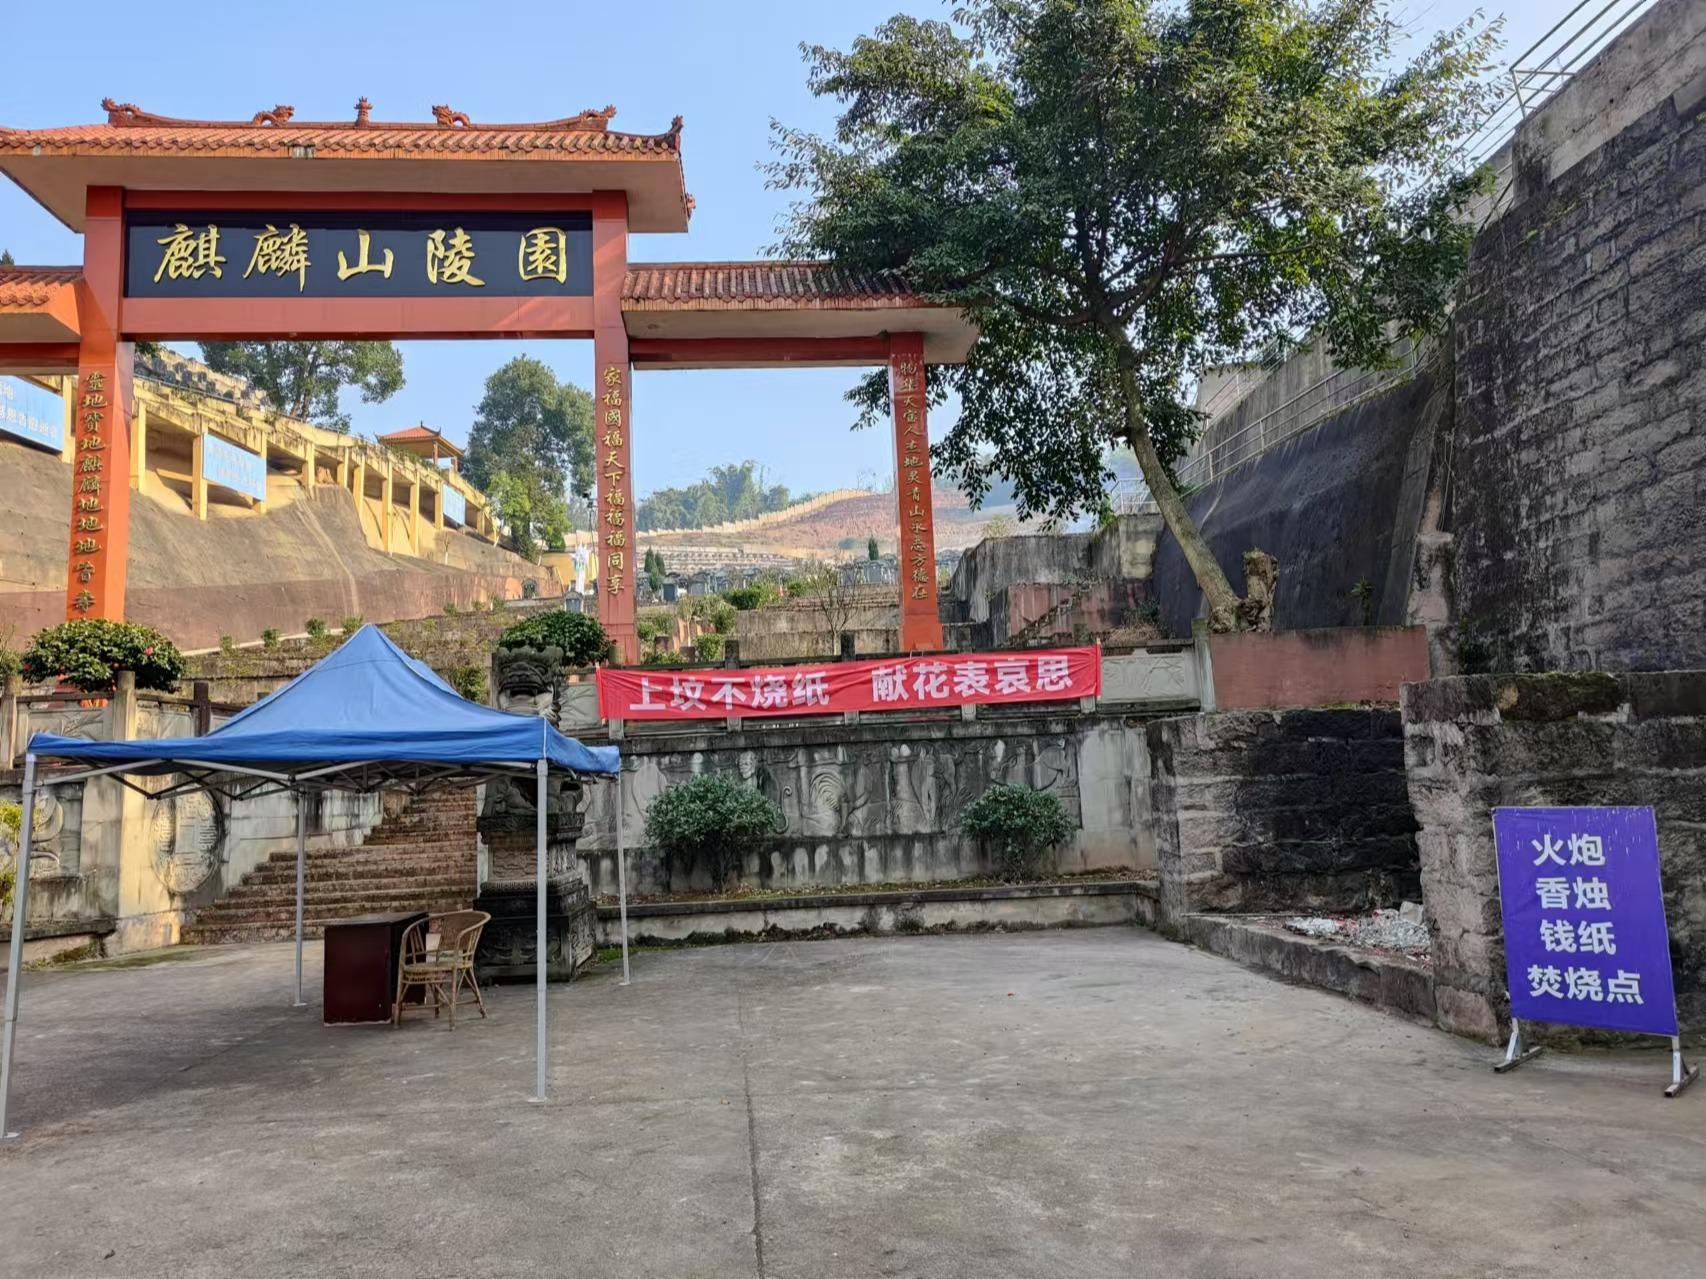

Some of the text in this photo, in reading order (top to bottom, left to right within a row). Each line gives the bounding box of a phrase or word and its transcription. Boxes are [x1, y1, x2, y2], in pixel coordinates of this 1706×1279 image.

[153, 223, 568, 292] 麒麟山陵園
[602, 366, 626, 596] 家福國福天下福福福同享
[629, 655, 1073, 711] 上坟不烧纸 献花表哀思
[1531, 833, 1606, 866] 火炮
[1535, 876, 1612, 910] 香烛
[1539, 919, 1616, 955] 钱纸
[1527, 964, 1644, 1004] 焚烧点
